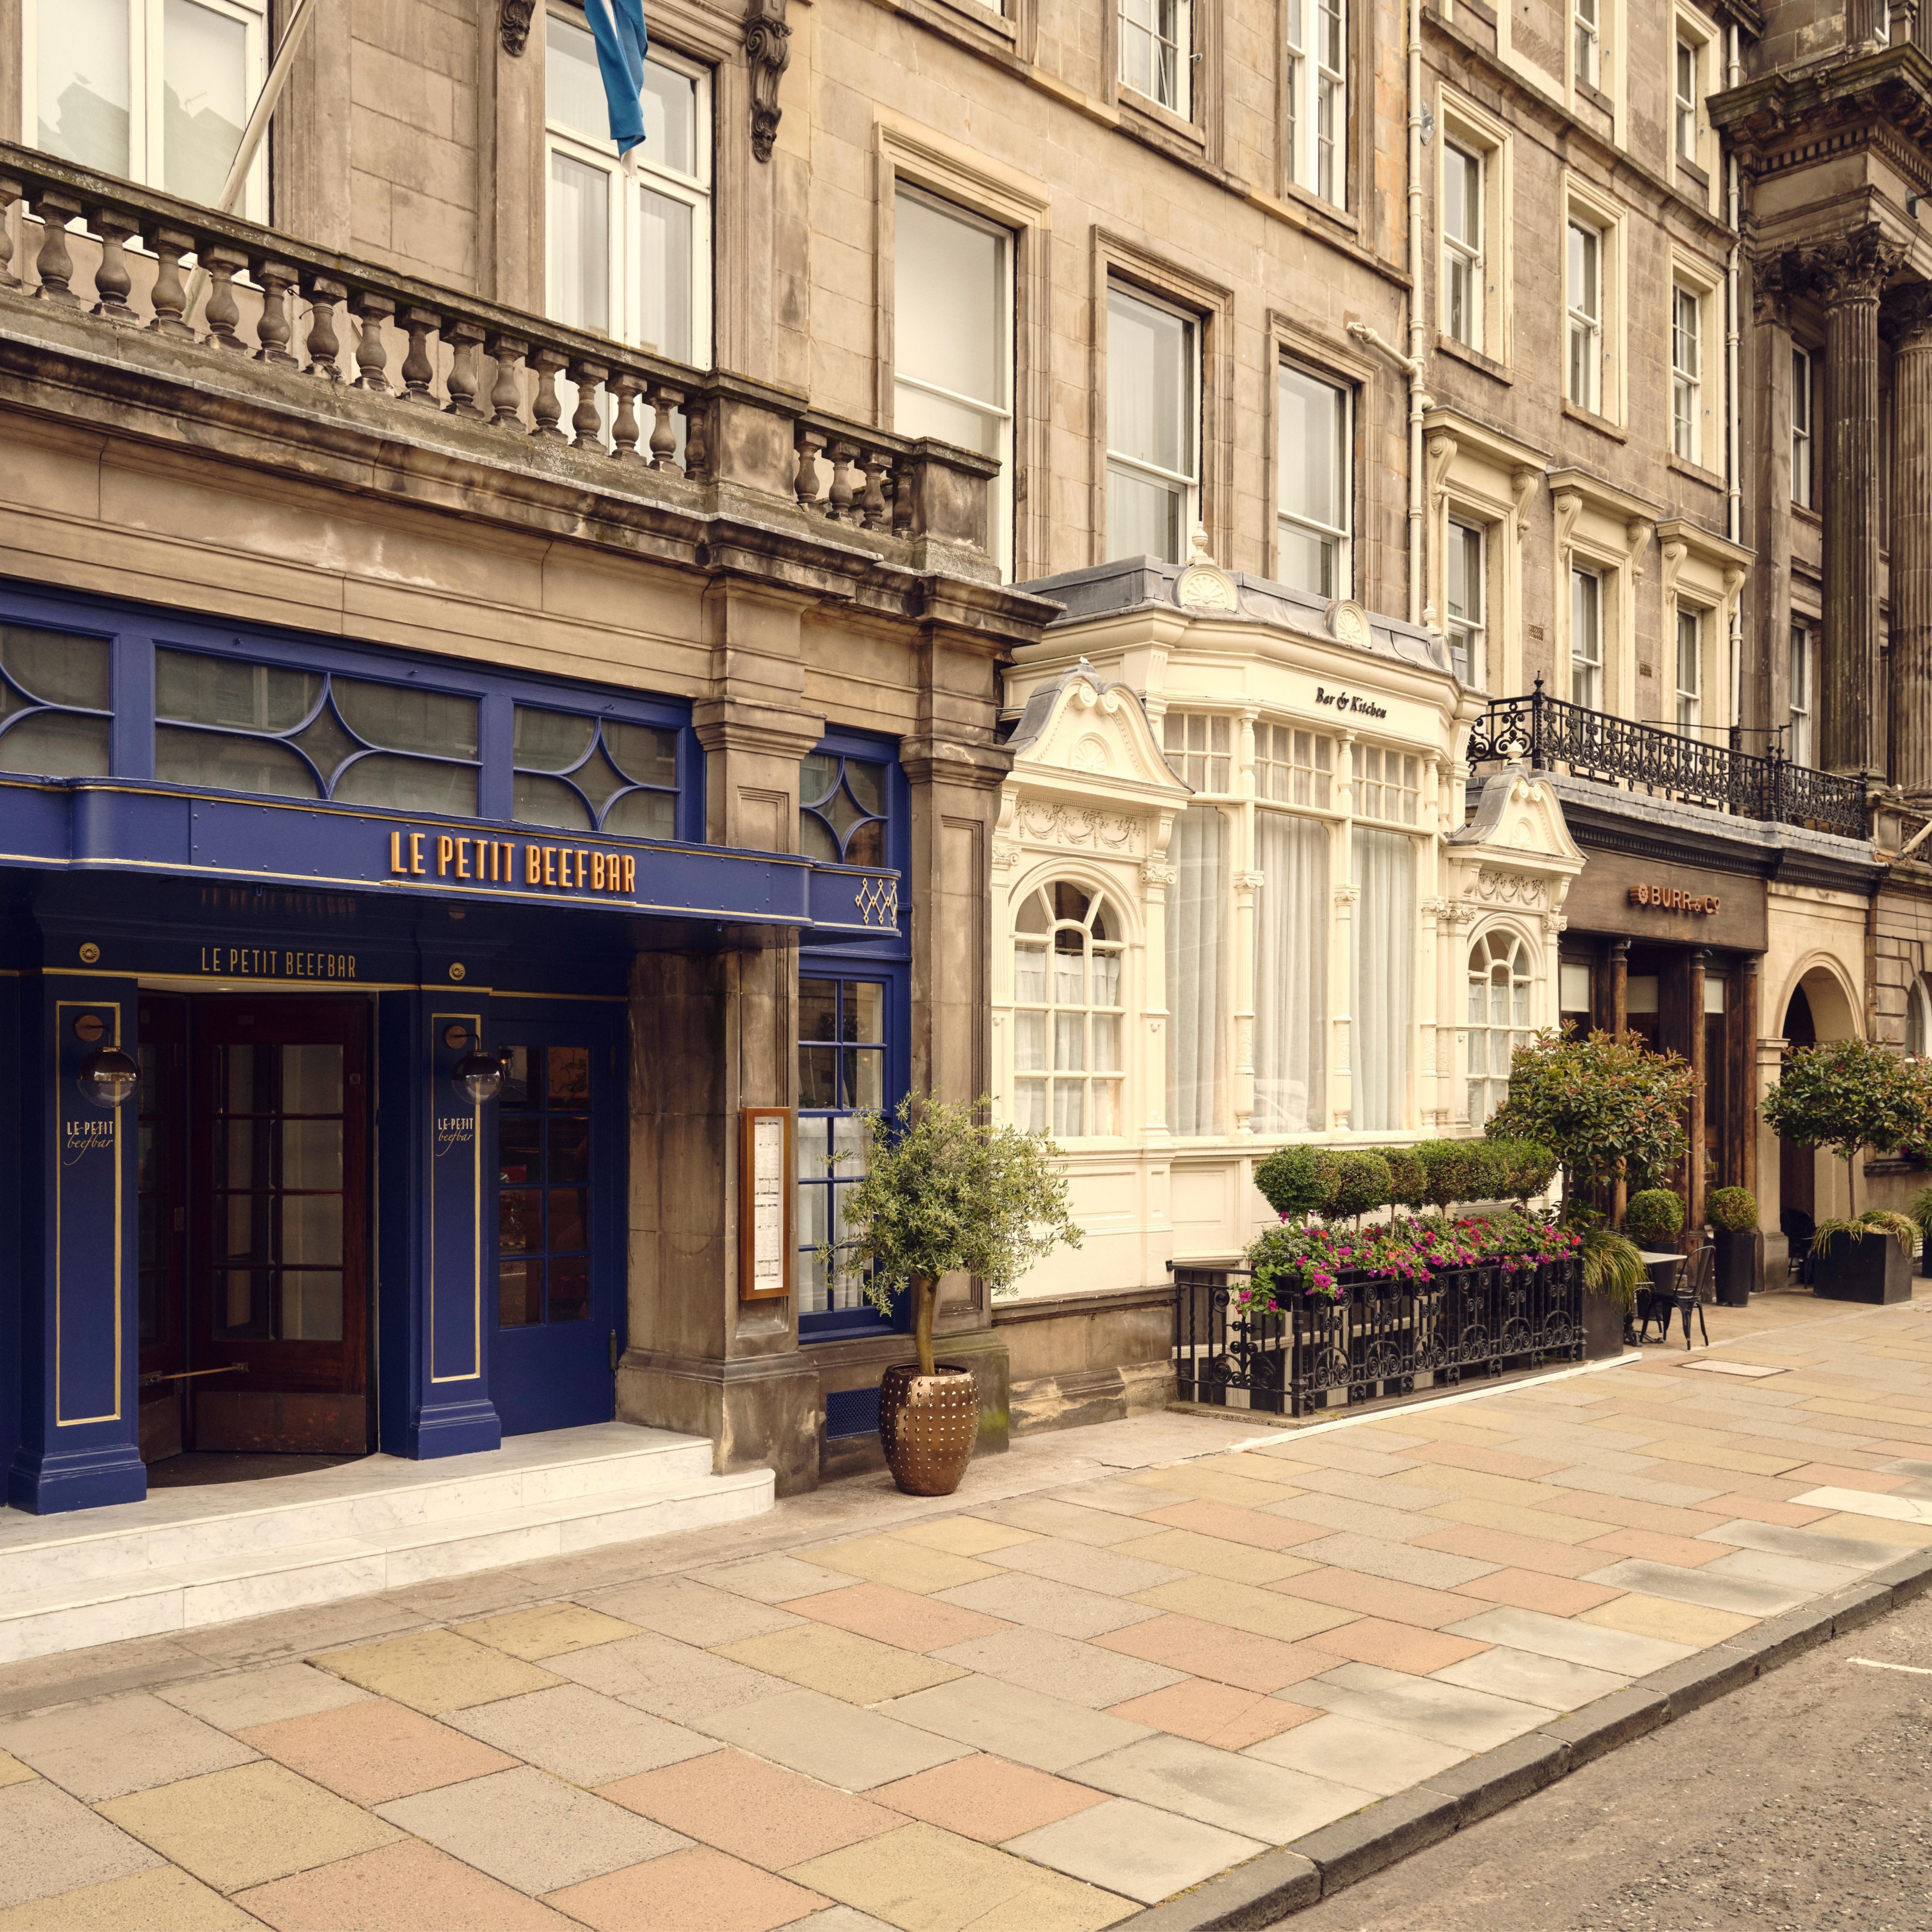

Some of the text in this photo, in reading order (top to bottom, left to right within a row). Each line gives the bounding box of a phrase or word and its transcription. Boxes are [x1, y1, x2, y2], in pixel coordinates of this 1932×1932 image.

[1315, 687, 1387, 718] Bar & Kitchen
[391, 831, 636, 893] LE PETIT BEEFBAR
[1649, 885, 1691, 910] BURR
[202, 947, 356, 978] LE PETIT BEEFBAR
[67, 1121, 114, 1135] LE PETIT
[436, 1122, 473, 1157] beefbar
[438, 1118, 473, 1130] LE PETIT
[63, 1126, 114, 1166] beefbar
